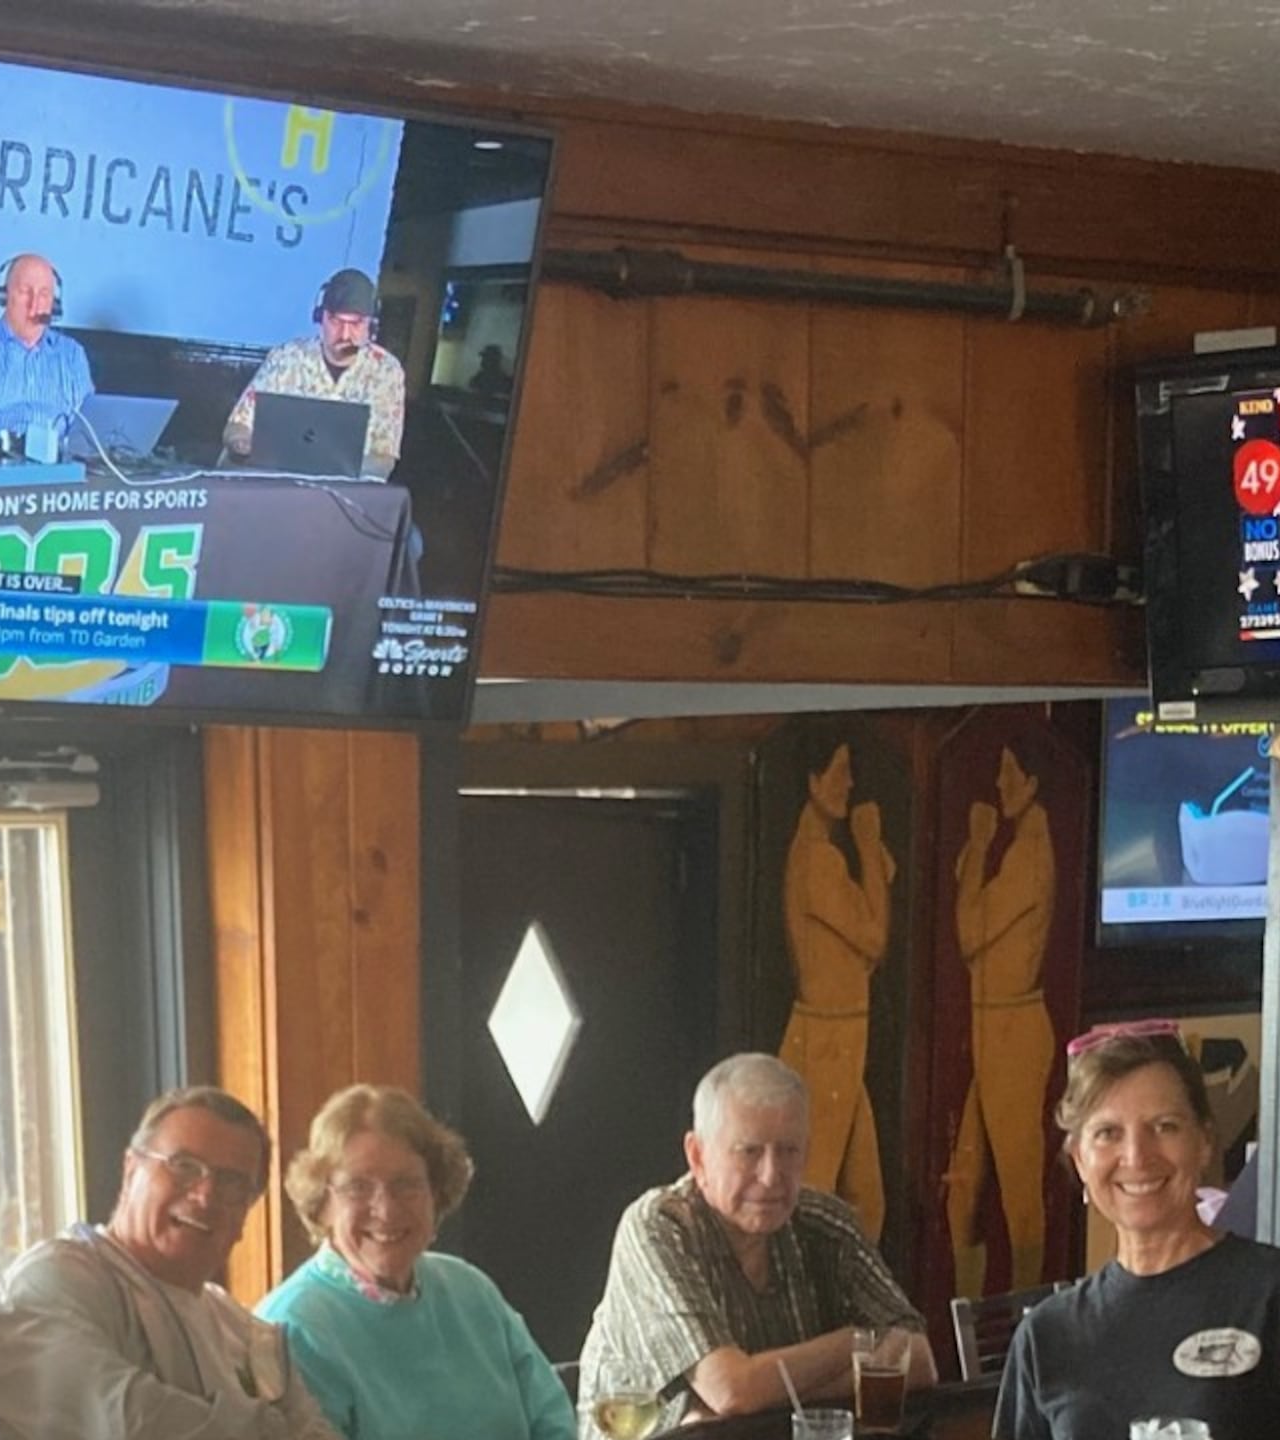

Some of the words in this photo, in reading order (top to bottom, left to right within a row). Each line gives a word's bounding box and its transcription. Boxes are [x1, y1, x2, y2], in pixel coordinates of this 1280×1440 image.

[1238, 399, 1274, 415] KENO
[1240, 458, 1280, 495] 49
[41, 490, 100, 513] HOME
[103, 489, 141, 510] FOR
[143, 488, 209, 509] SPORTS
[1245, 519, 1278, 541] NO
[1243, 540, 1280, 562] BONUS
[5, 573, 21, 588] IS
[43, 605, 75, 627] tips
[78, 605, 109, 625] off
[108, 607, 170, 631] tonight
[28, 626, 65, 645] from
[69, 627, 89, 646] TD
[91, 629, 146, 648] Garden
[378, 661, 453, 677] BOSTON
